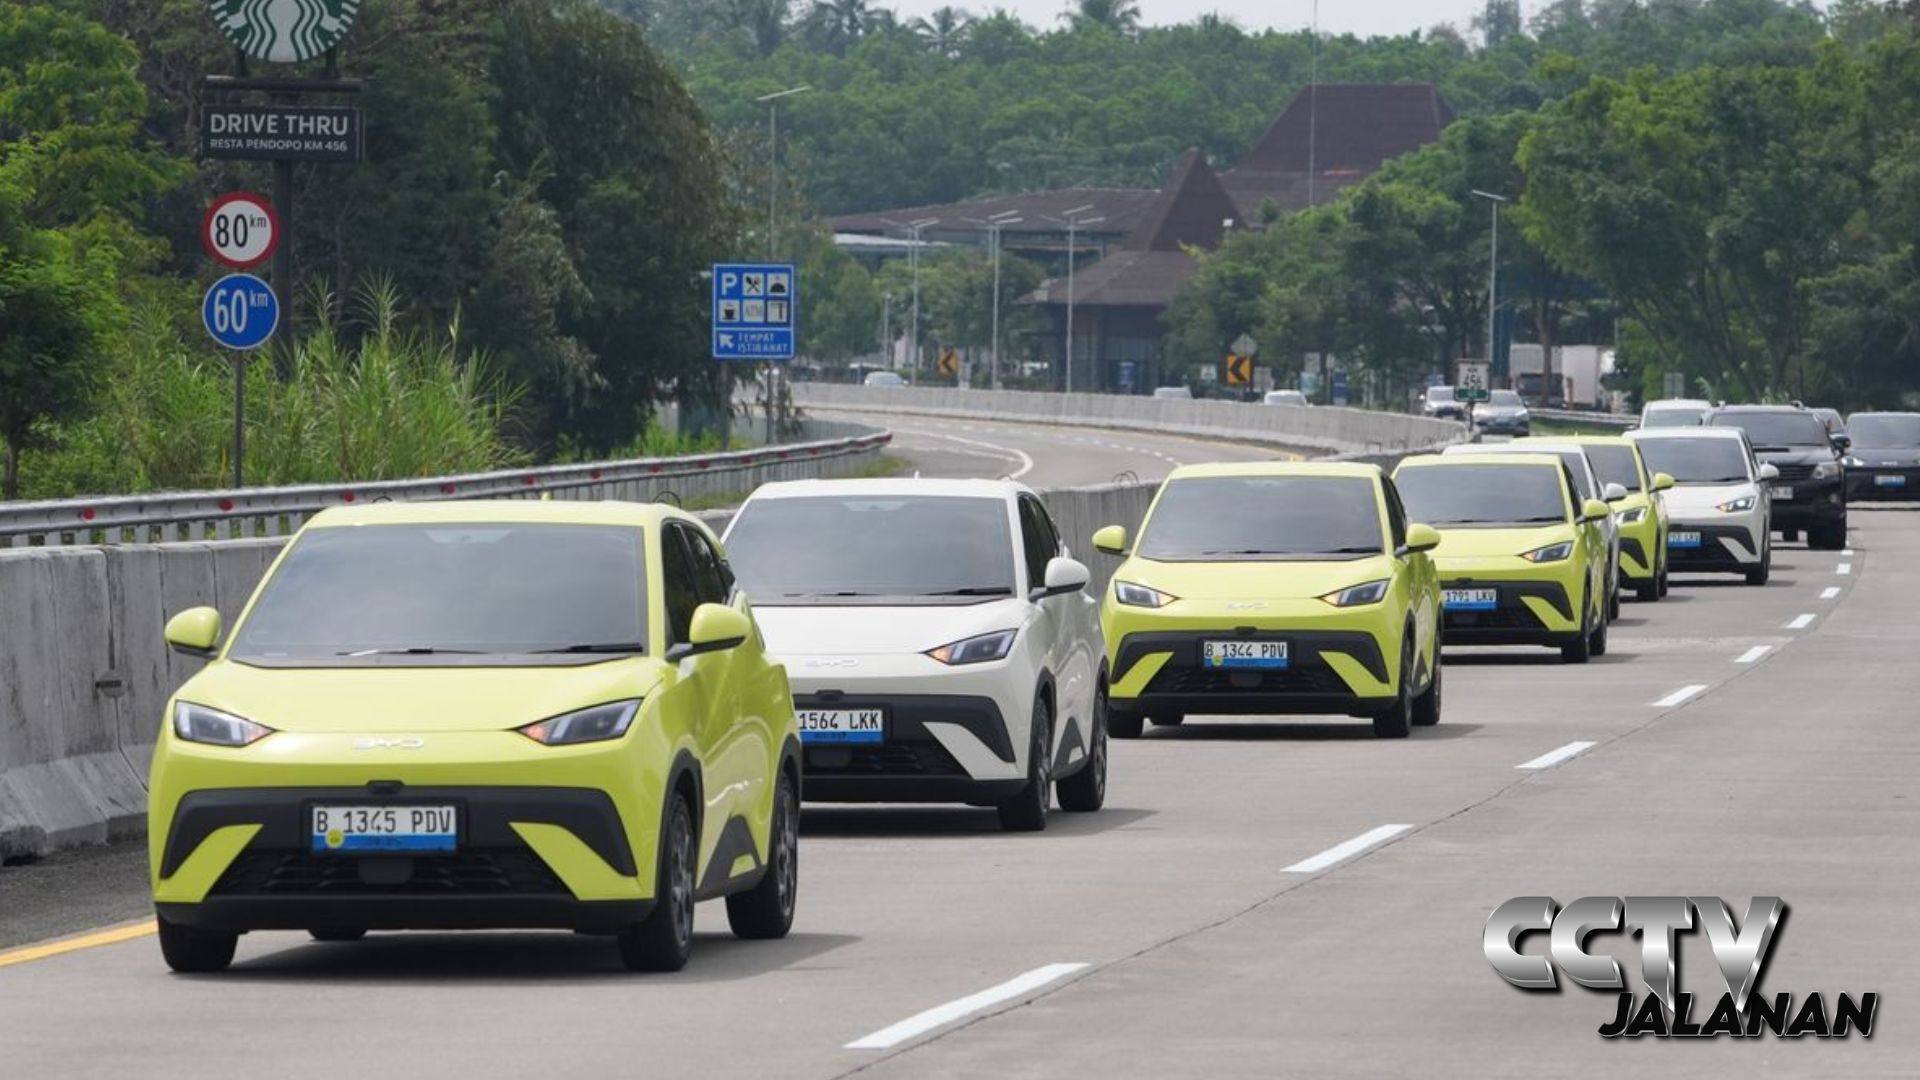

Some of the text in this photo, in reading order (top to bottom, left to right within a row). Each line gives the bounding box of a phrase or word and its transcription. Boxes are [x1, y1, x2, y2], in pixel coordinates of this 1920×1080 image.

[210, 114, 348, 135] DRIVE THRU
[210, 139, 348, 152] RESTA PENDOPO KM 456
[215, 214, 249, 248] 80
[721, 272, 737, 296] P
[214, 288, 248, 333] 60
[738, 332, 775, 342] TEMPAT
[737, 343, 788, 353] ISTIRAHAT
[1205, 643, 1286, 658] B 1344 PDV
[799, 712, 879, 730] 1564 LKK
[353, 736, 424, 750] BYD
[316, 810, 451, 834] B 1345 PDV
